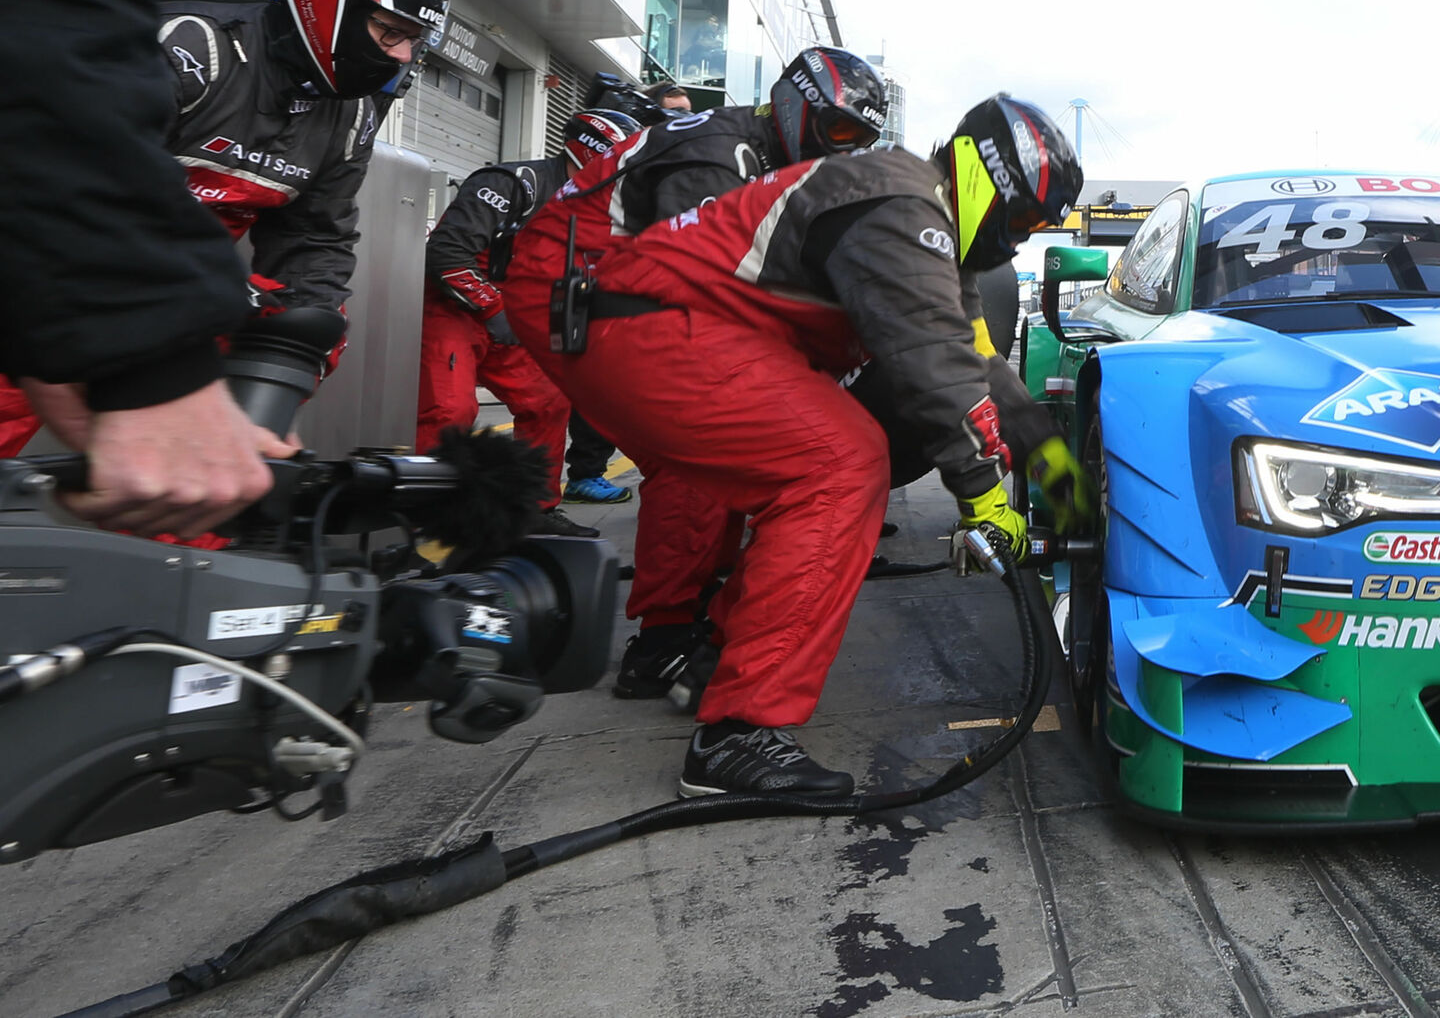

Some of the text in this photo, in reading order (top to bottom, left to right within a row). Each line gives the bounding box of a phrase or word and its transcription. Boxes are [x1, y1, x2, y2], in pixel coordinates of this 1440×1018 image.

[418, 5, 446, 27] uve
[449, 20, 477, 49] MOTION
[441, 39, 490, 77] AND MOBILITY
[791, 69, 829, 110] uvex
[230, 143, 311, 180] Adi Sprt
[578, 132, 608, 155] uve
[979, 137, 1020, 204] uvex
[188, 183, 228, 200] udi
[1216, 201, 1371, 255] 48
